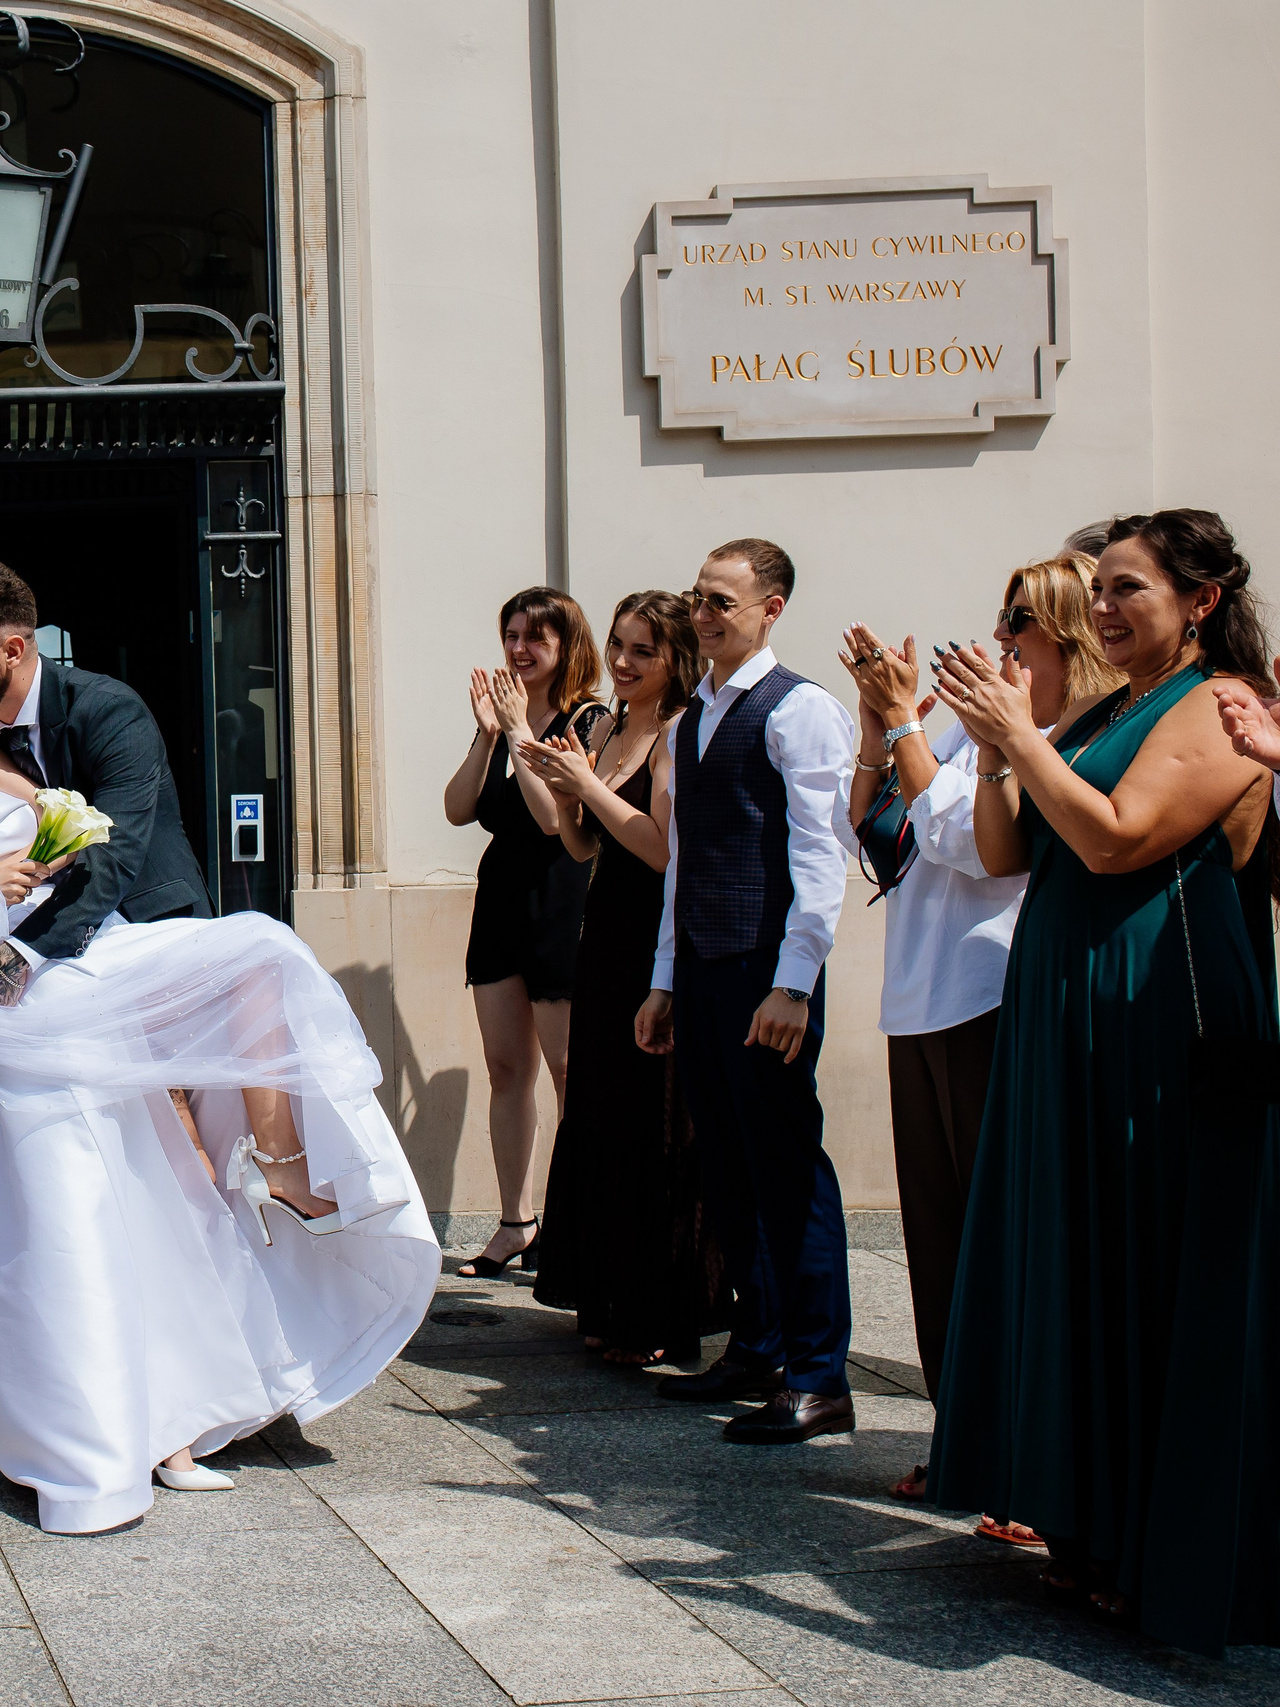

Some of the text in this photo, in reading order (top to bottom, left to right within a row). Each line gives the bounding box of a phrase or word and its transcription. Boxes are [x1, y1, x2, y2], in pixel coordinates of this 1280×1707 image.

[683, 230, 1026, 268] URZĄD STANU CYWILNEGO
[743, 279, 966, 307] M. ST. WARSZAWY
[0, 309, 9, 329] 6
[710, 336, 1004, 384] PAŁAC ŚLUBÓW
